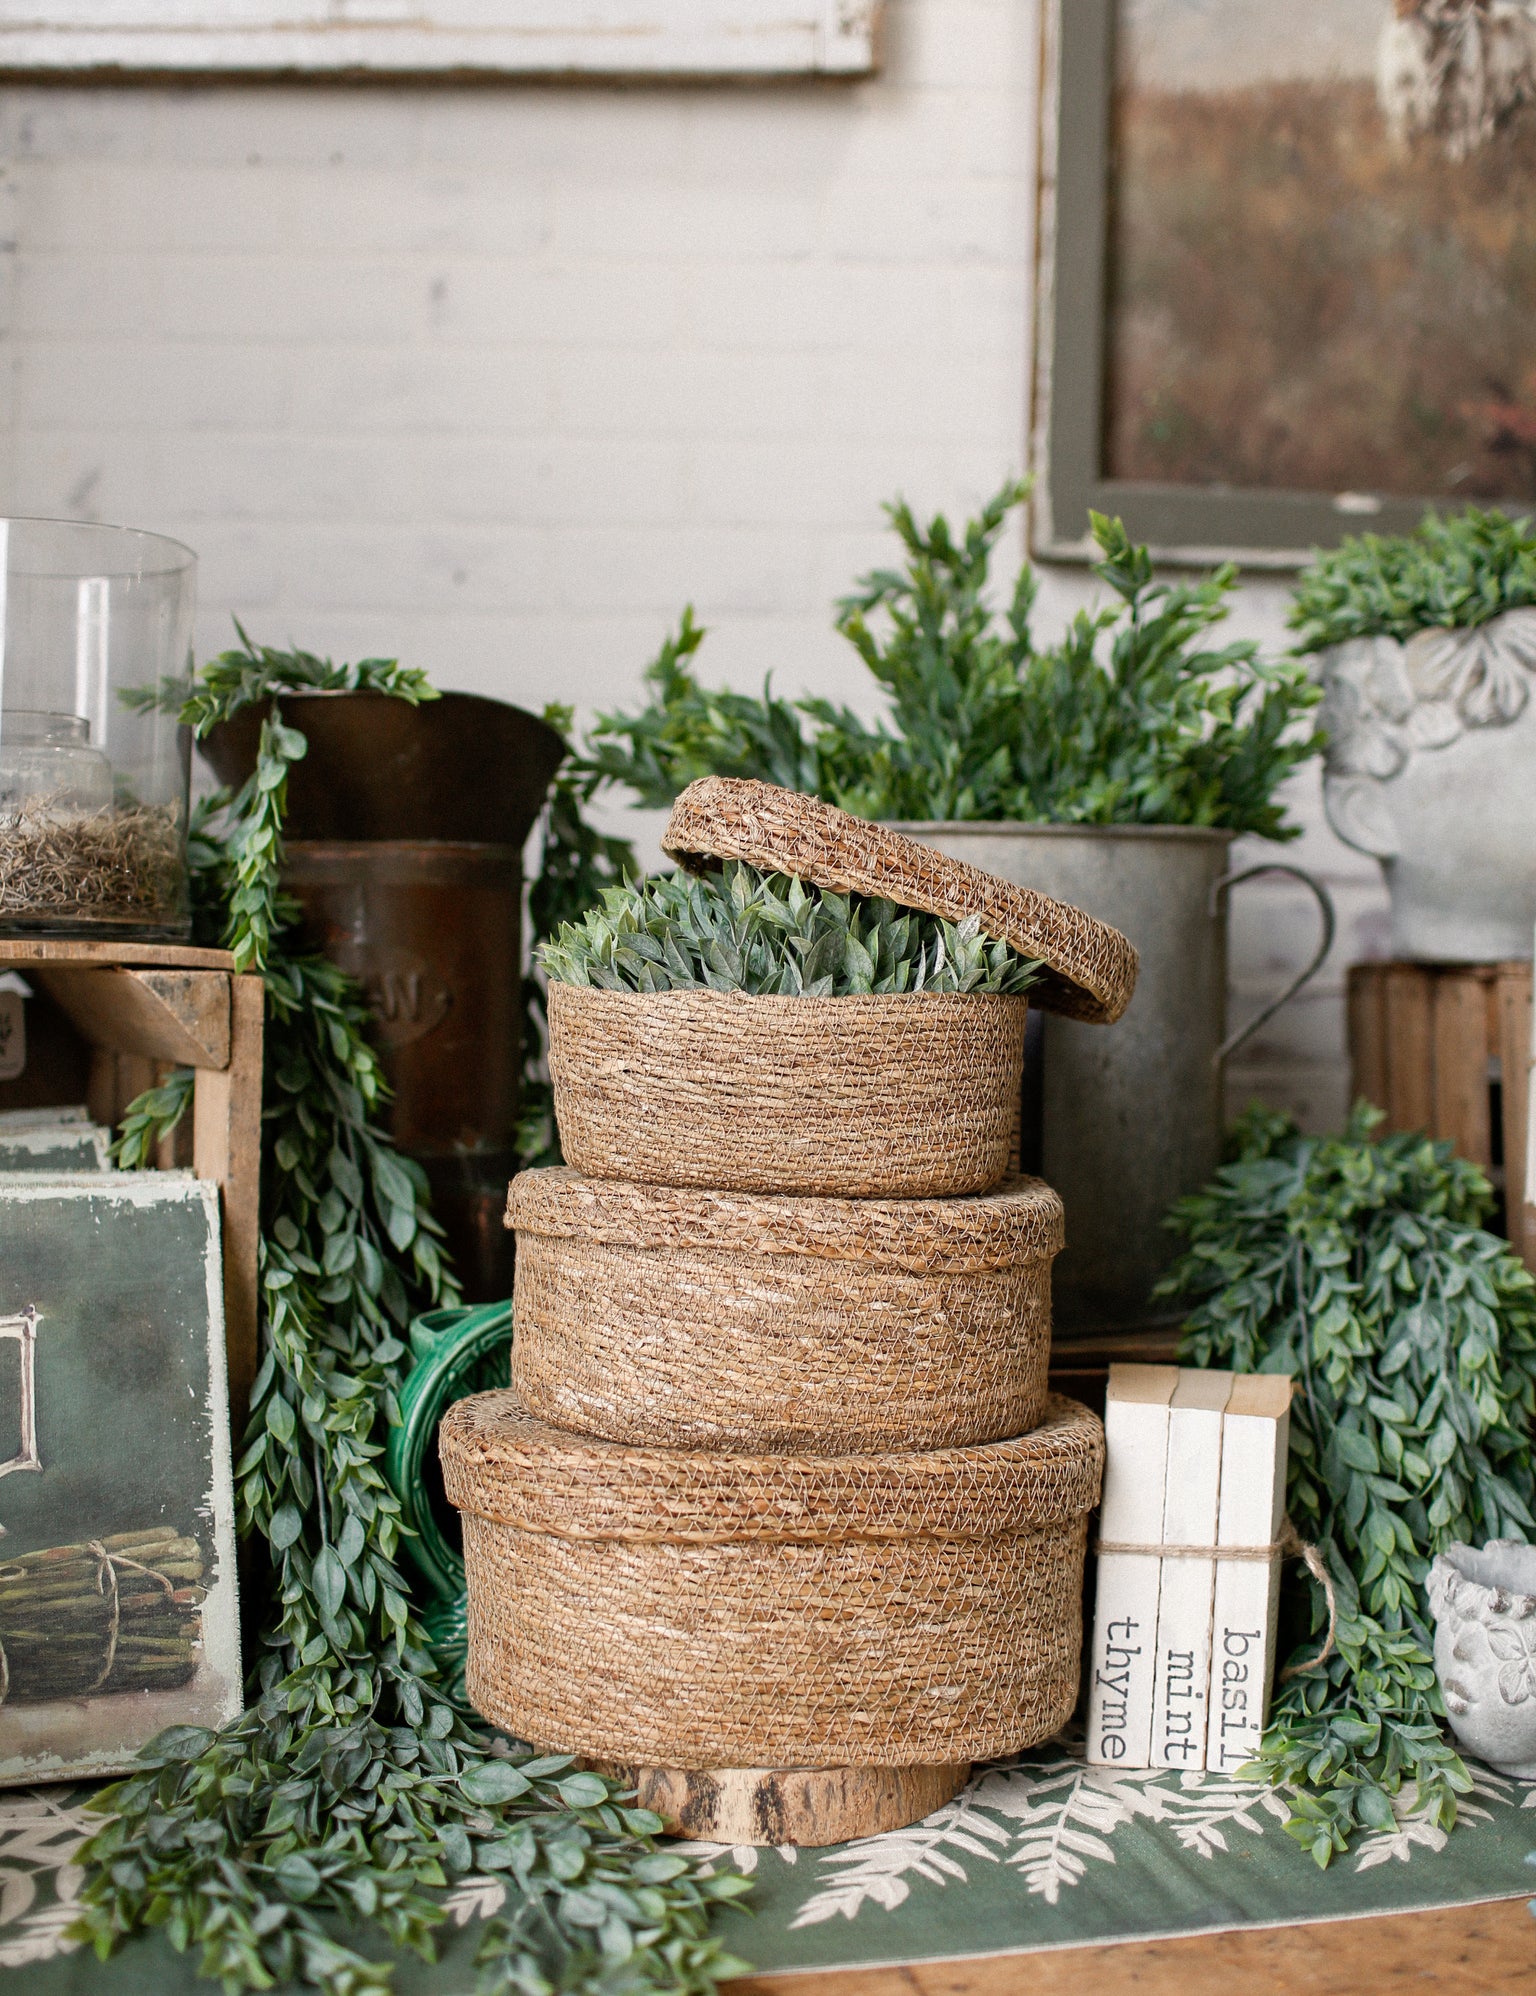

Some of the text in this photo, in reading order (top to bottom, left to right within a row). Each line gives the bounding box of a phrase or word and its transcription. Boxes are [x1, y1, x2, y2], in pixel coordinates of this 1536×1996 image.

[1095, 1616, 1141, 1760] thyme
[1163, 1650, 1203, 1761] mint
[1220, 1628, 1261, 1767] basil
